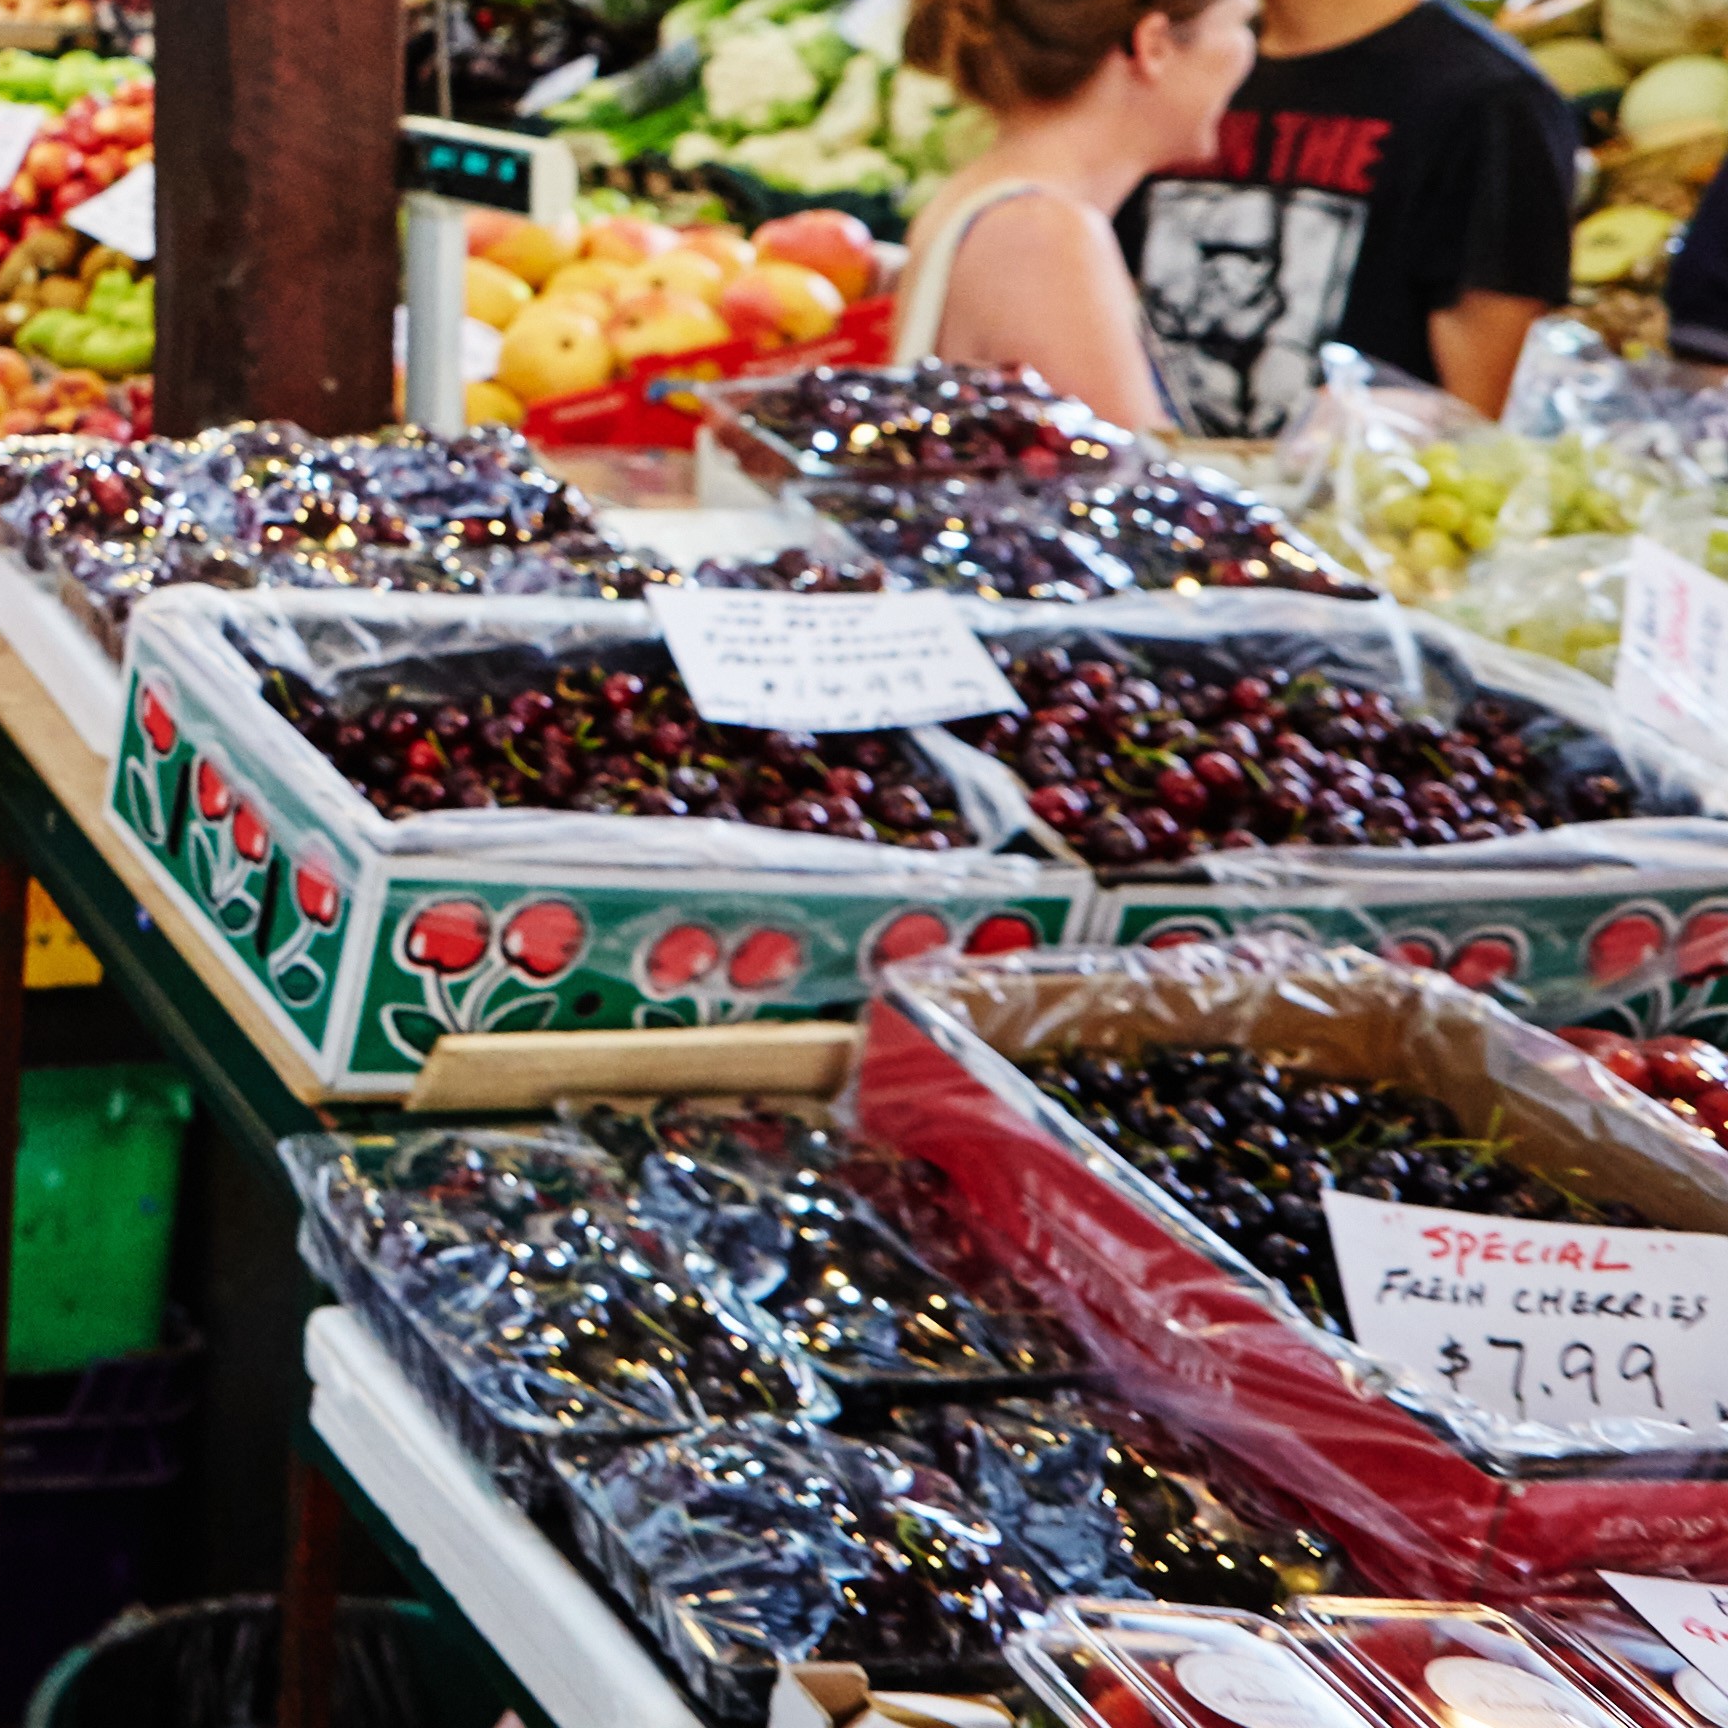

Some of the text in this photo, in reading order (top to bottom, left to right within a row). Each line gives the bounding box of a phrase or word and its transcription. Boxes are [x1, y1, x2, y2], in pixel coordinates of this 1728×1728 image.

[1419, 1226, 1632, 1275] SPECIAL
[1377, 1268, 1709, 1328] FRESH CHERRIES
[1437, 1336, 1665, 1420] $7.99
